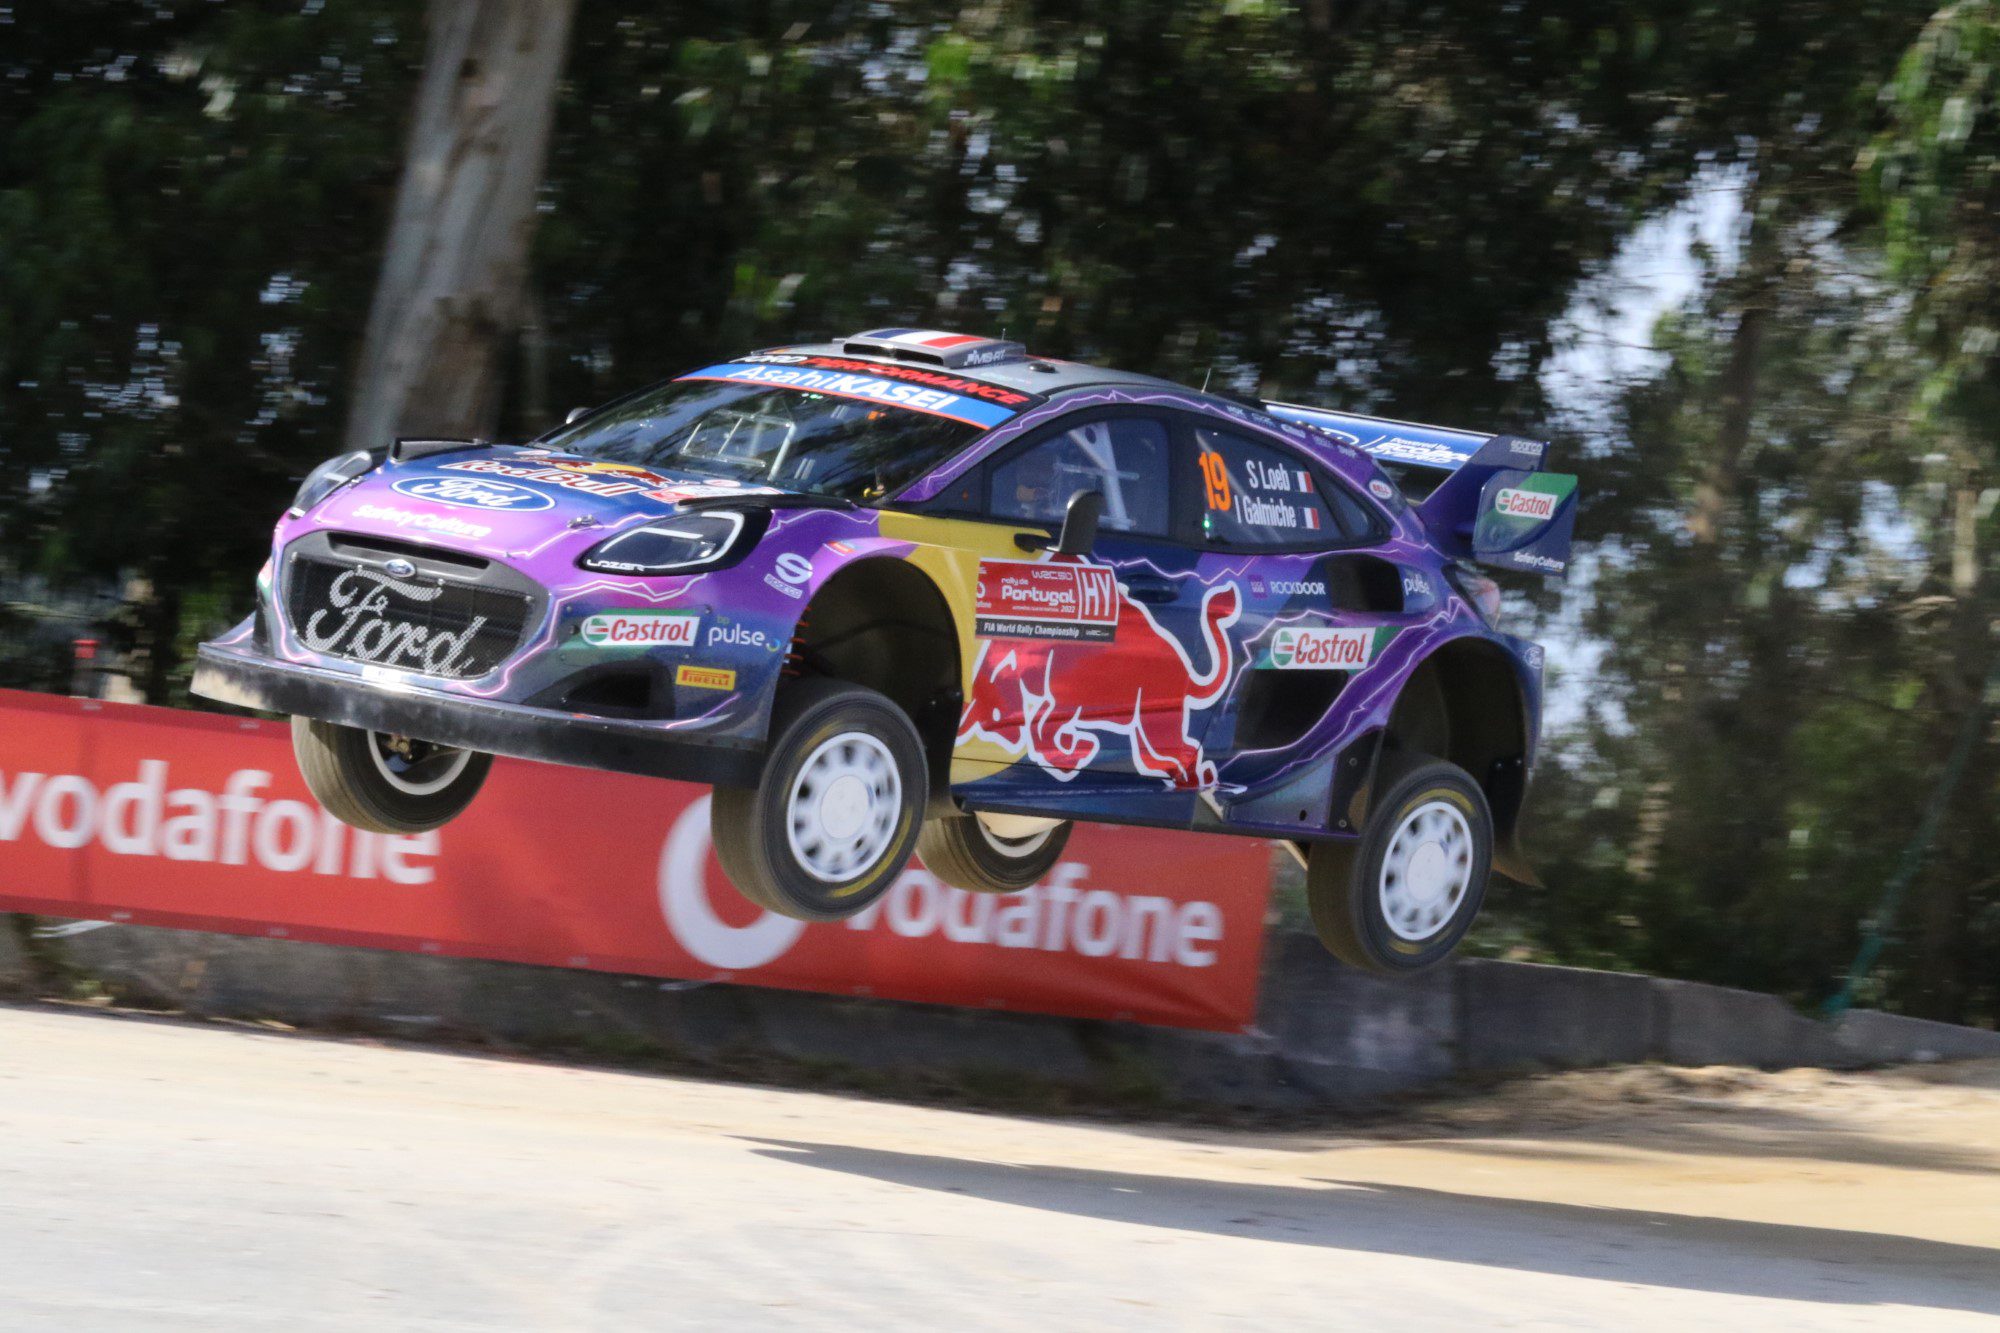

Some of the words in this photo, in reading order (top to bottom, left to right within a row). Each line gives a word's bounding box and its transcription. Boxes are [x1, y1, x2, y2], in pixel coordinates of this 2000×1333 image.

[726, 365, 959, 410] AsahiKASEI
[800, 357, 1030, 404] PERFORMANCE
[1510, 440, 1543, 452] sparco
[524, 469, 648, 497] Bull
[1199, 452, 1231, 511] 19
[1246, 460, 1258, 488] S
[1258, 461, 1290, 491] Loeb
[411, 480, 531, 506] Ford
[1510, 493, 1552, 515] Castrol
[353, 504, 492, 537] SafetyCulture
[1234, 495, 1241, 523] I
[1243, 497, 1297, 528] Galmiche
[1514, 552, 1565, 570] SafetyCulture
[1001, 585, 1076, 606] Portugal
[1081, 572, 1111, 617] HY
[1270, 581, 1326, 595] ROCKDOOR
[1403, 575, 1430, 596] pulse
[305, 567, 488, 677] Ford
[611, 619, 690, 642] Castrol
[708, 623, 766, 647] pulse
[984, 622, 995, 632] FIA
[996, 623, 1015, 633] World
[1016, 624, 1034, 634] Rally
[1034, 625, 1080, 639] Championship
[1294, 632, 1367, 664] Castrol
[681, 668, 731, 688] PIRELLI
